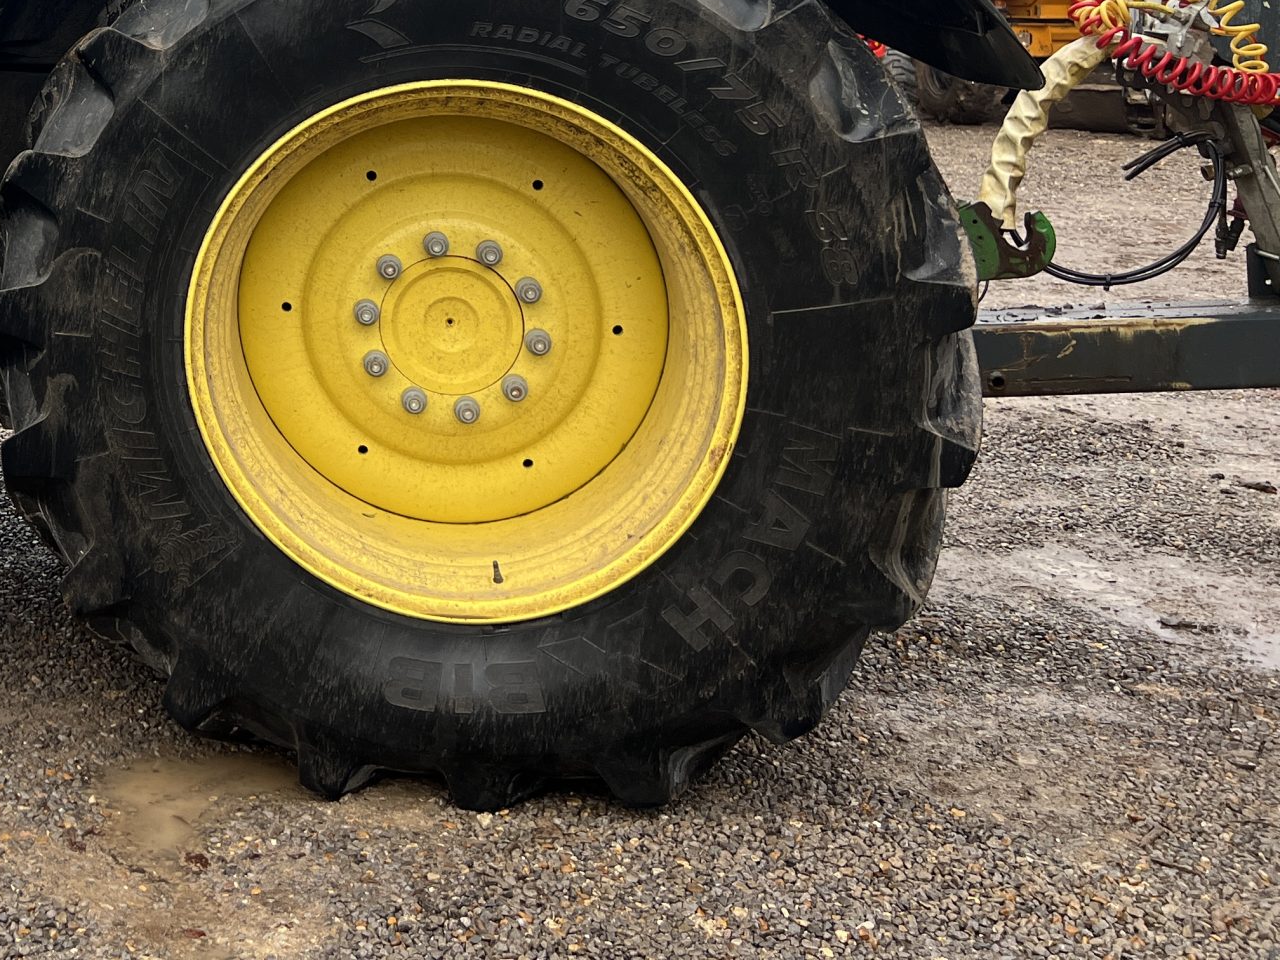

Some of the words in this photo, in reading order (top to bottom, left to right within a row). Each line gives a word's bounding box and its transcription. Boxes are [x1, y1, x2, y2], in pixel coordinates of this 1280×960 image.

[469, 21, 588, 60] RADIAL
[598, 53, 739, 158] TUBELESS
[769, 147, 821, 192] R
[101, 146, 191, 521] MICHELIN
[661, 439, 838, 653] MACH
[382, 655, 547, 715] BIB
